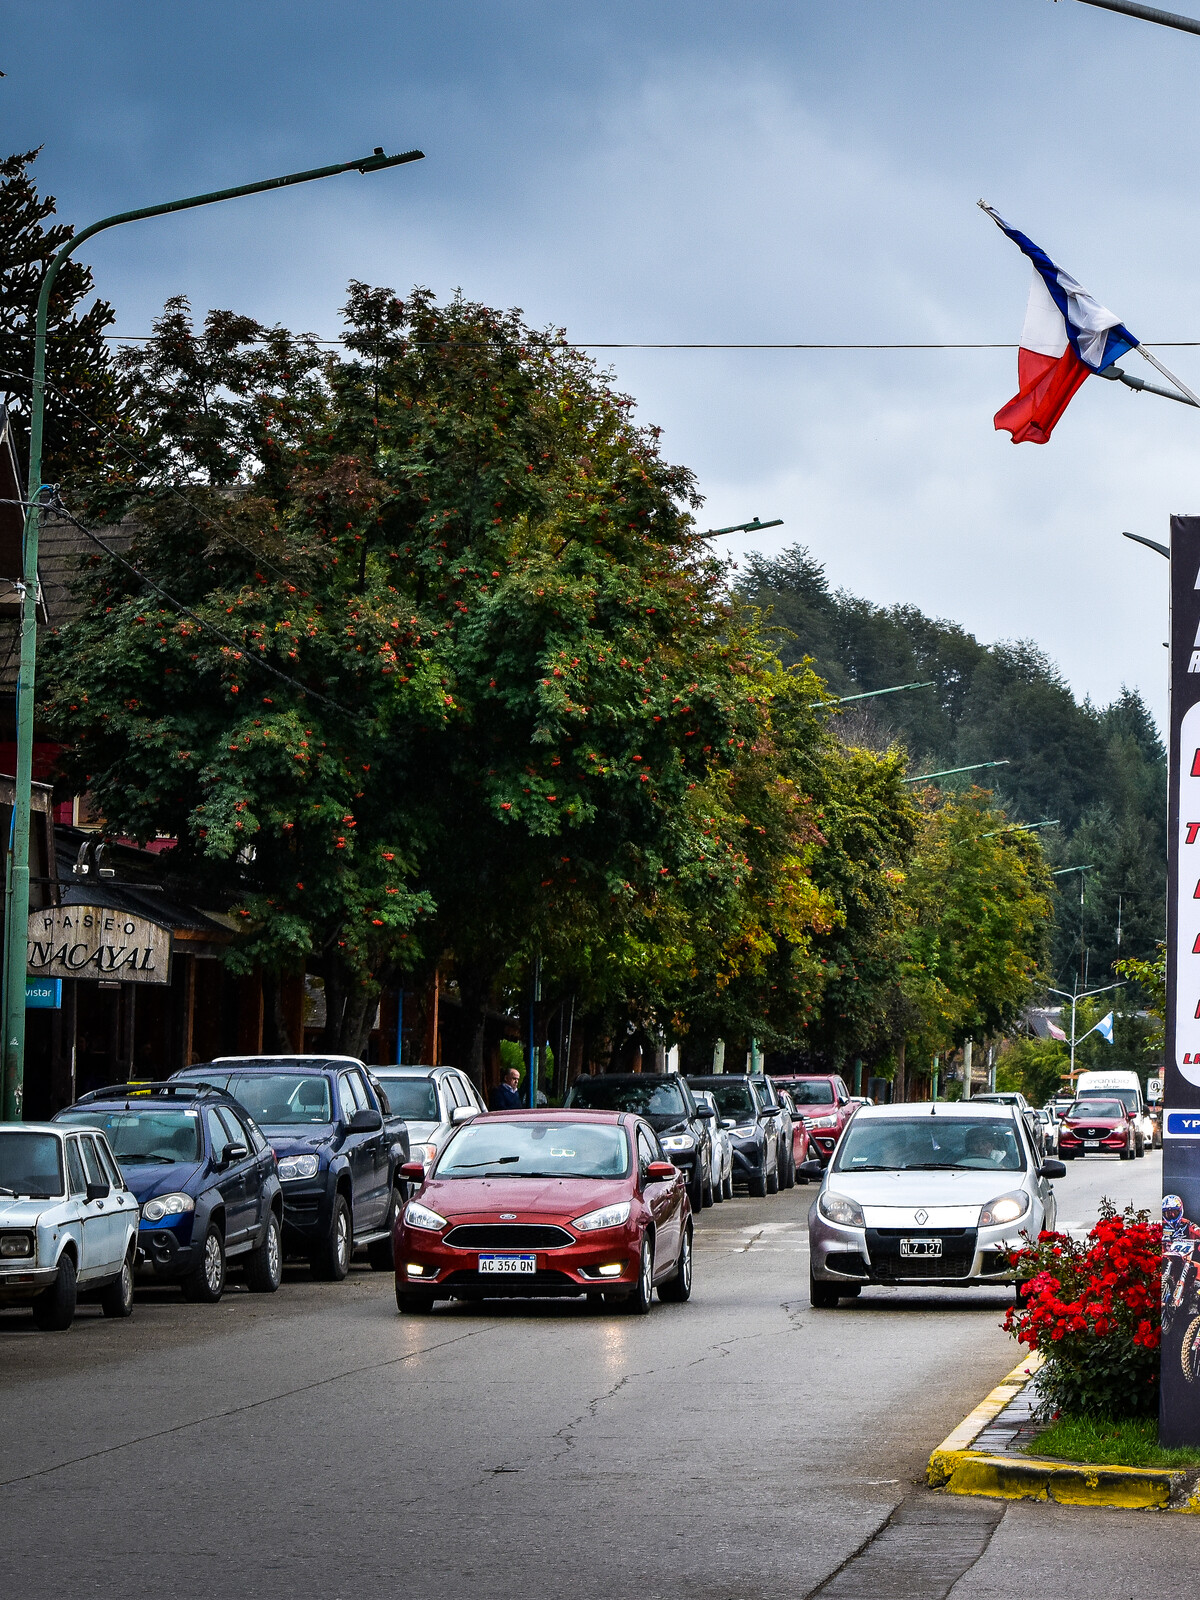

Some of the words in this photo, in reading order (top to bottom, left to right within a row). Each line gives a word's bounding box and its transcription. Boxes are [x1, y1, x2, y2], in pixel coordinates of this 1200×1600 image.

[27, 941, 156, 973] NACAYAL
[25, 987, 52, 997] vistar
[902, 1243, 919, 1254] NLZ
[923, 1243, 941, 1254] 127
[481, 1260, 495, 1271] AC
[497, 1260, 517, 1271] 356
[520, 1261, 533, 1271] QN
